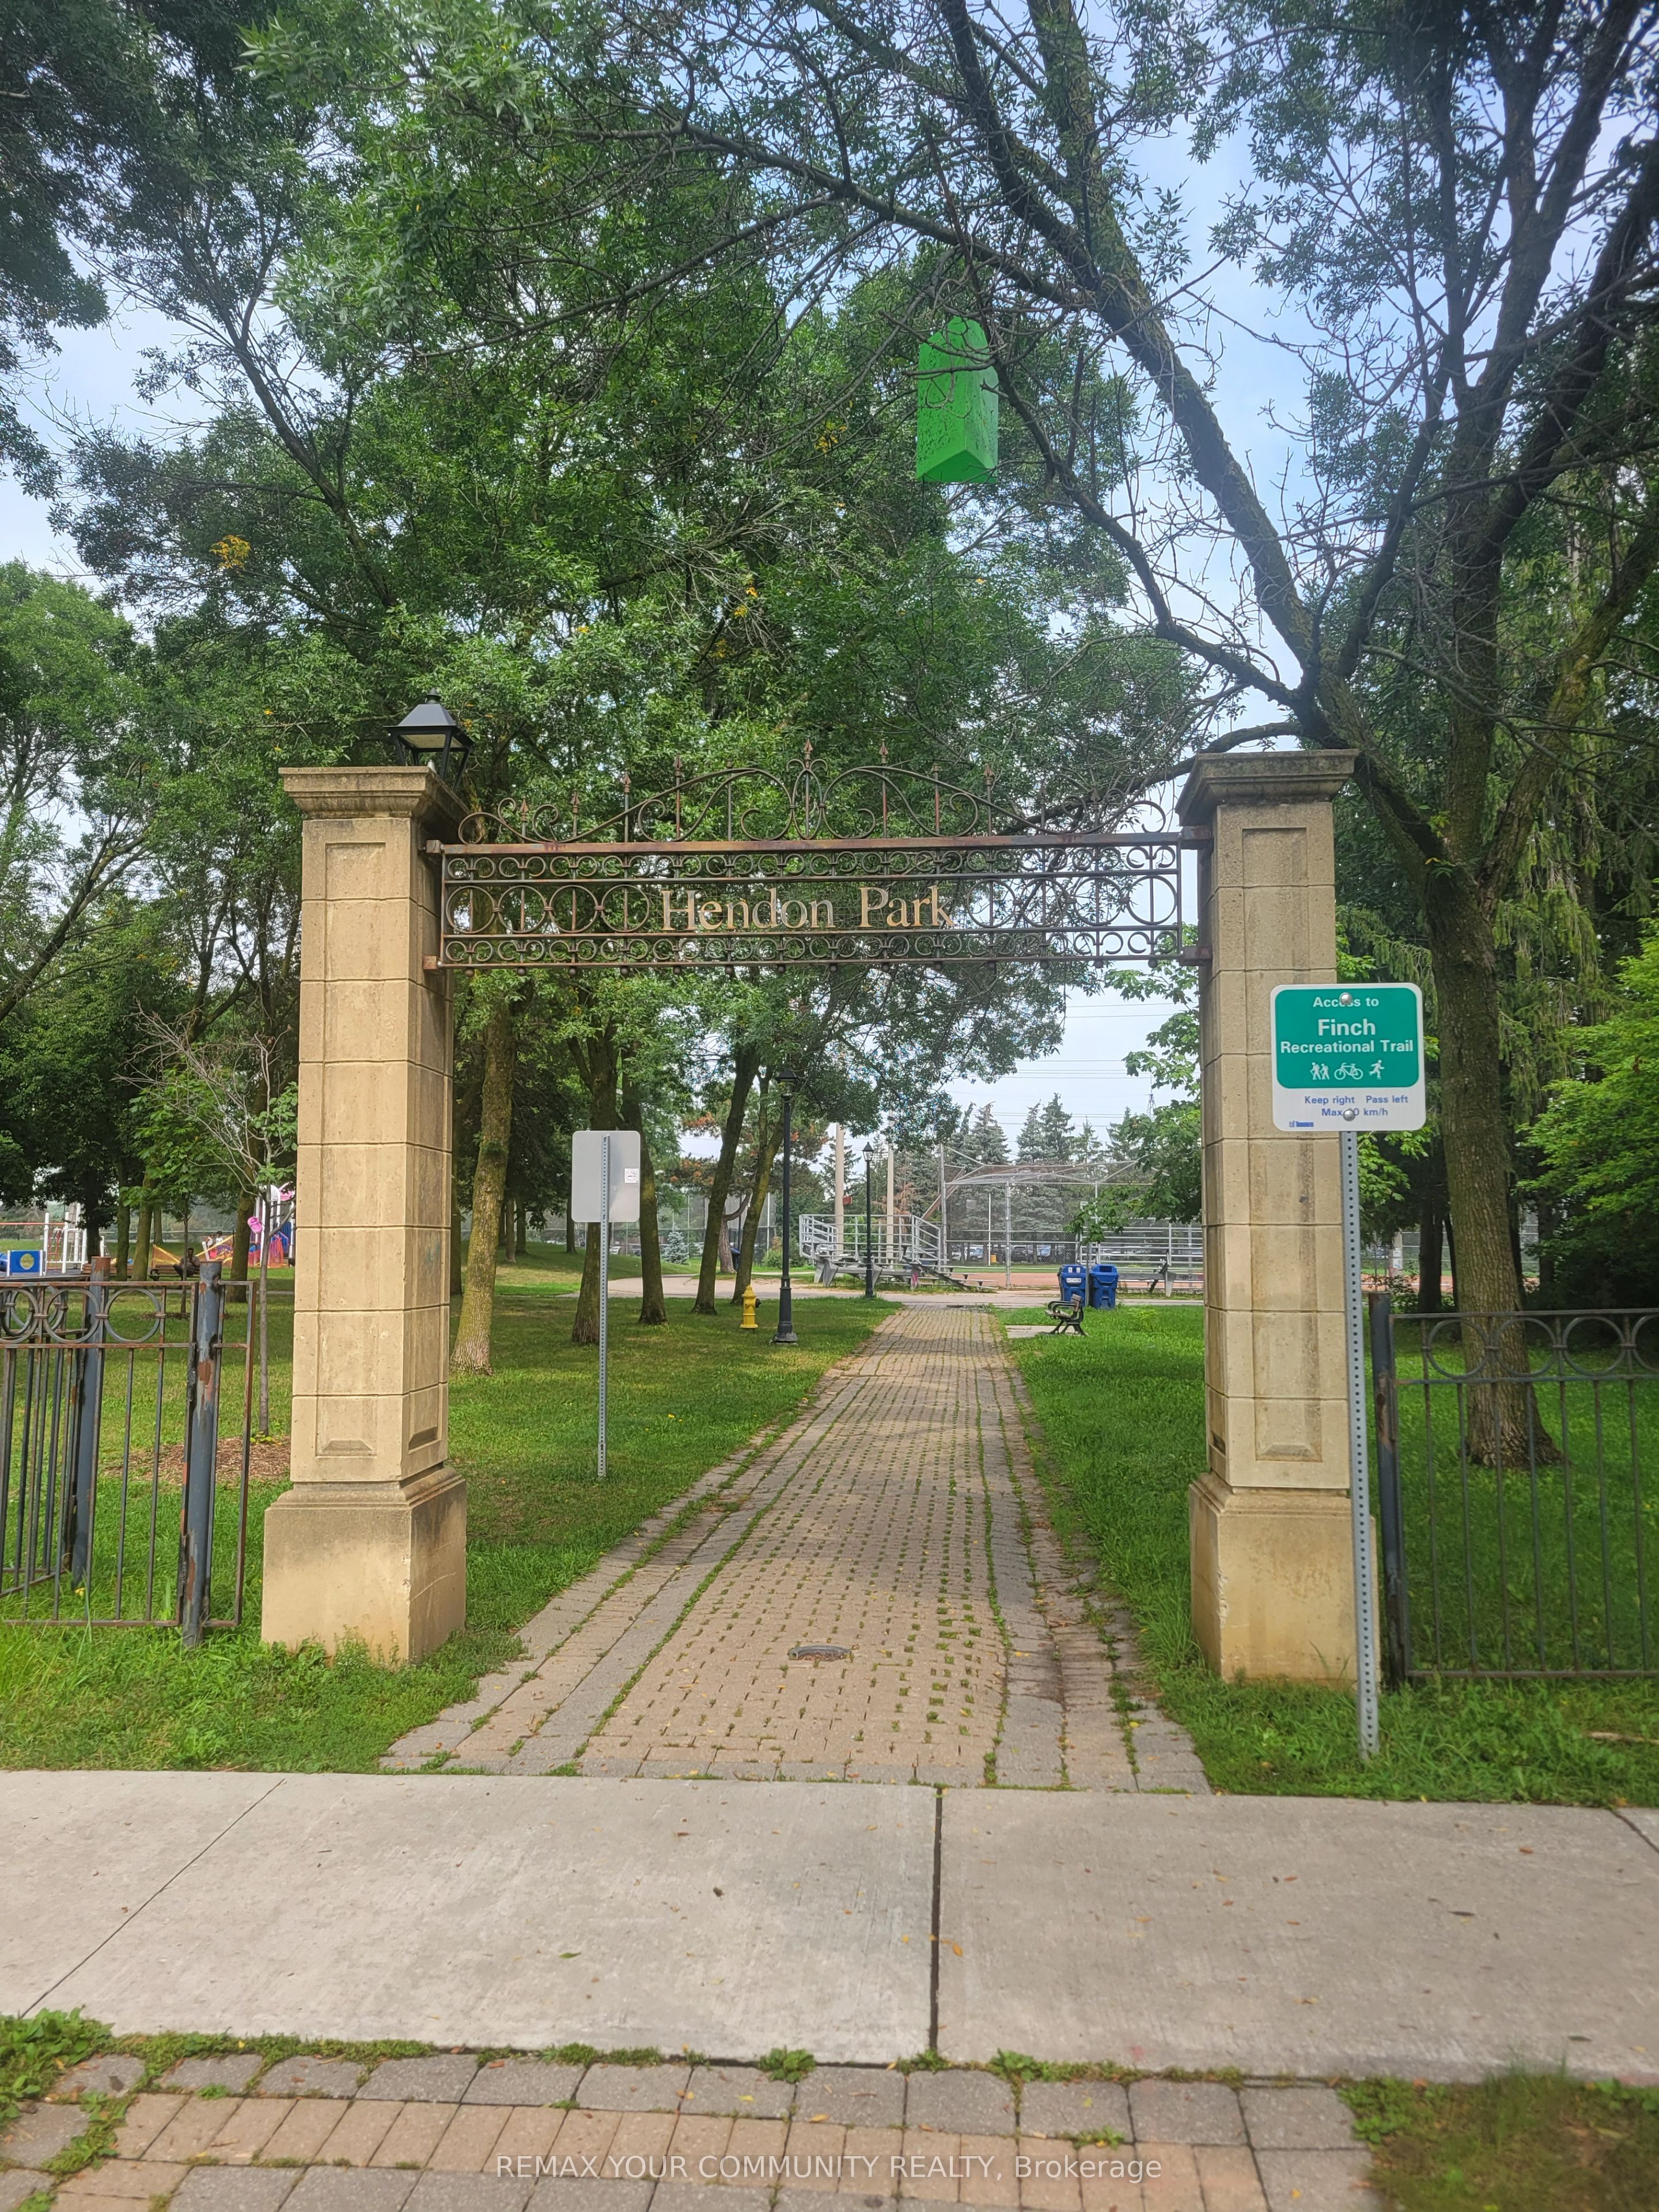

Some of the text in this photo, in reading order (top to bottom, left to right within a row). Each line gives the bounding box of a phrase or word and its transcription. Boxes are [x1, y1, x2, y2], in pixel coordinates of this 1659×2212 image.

[660, 885, 957, 930] Hendon Park
[1365, 997, 1380, 1007] to
[1318, 1018, 1376, 1036] Finch
[1281, 1039, 1413, 1053] Recreational Trail
[1305, 1096, 1329, 1105] Keep
[1332, 1096, 1355, 1105] right
[1392, 1095, 1408, 1103] left
[1363, 1108, 1388, 1116] km/h
